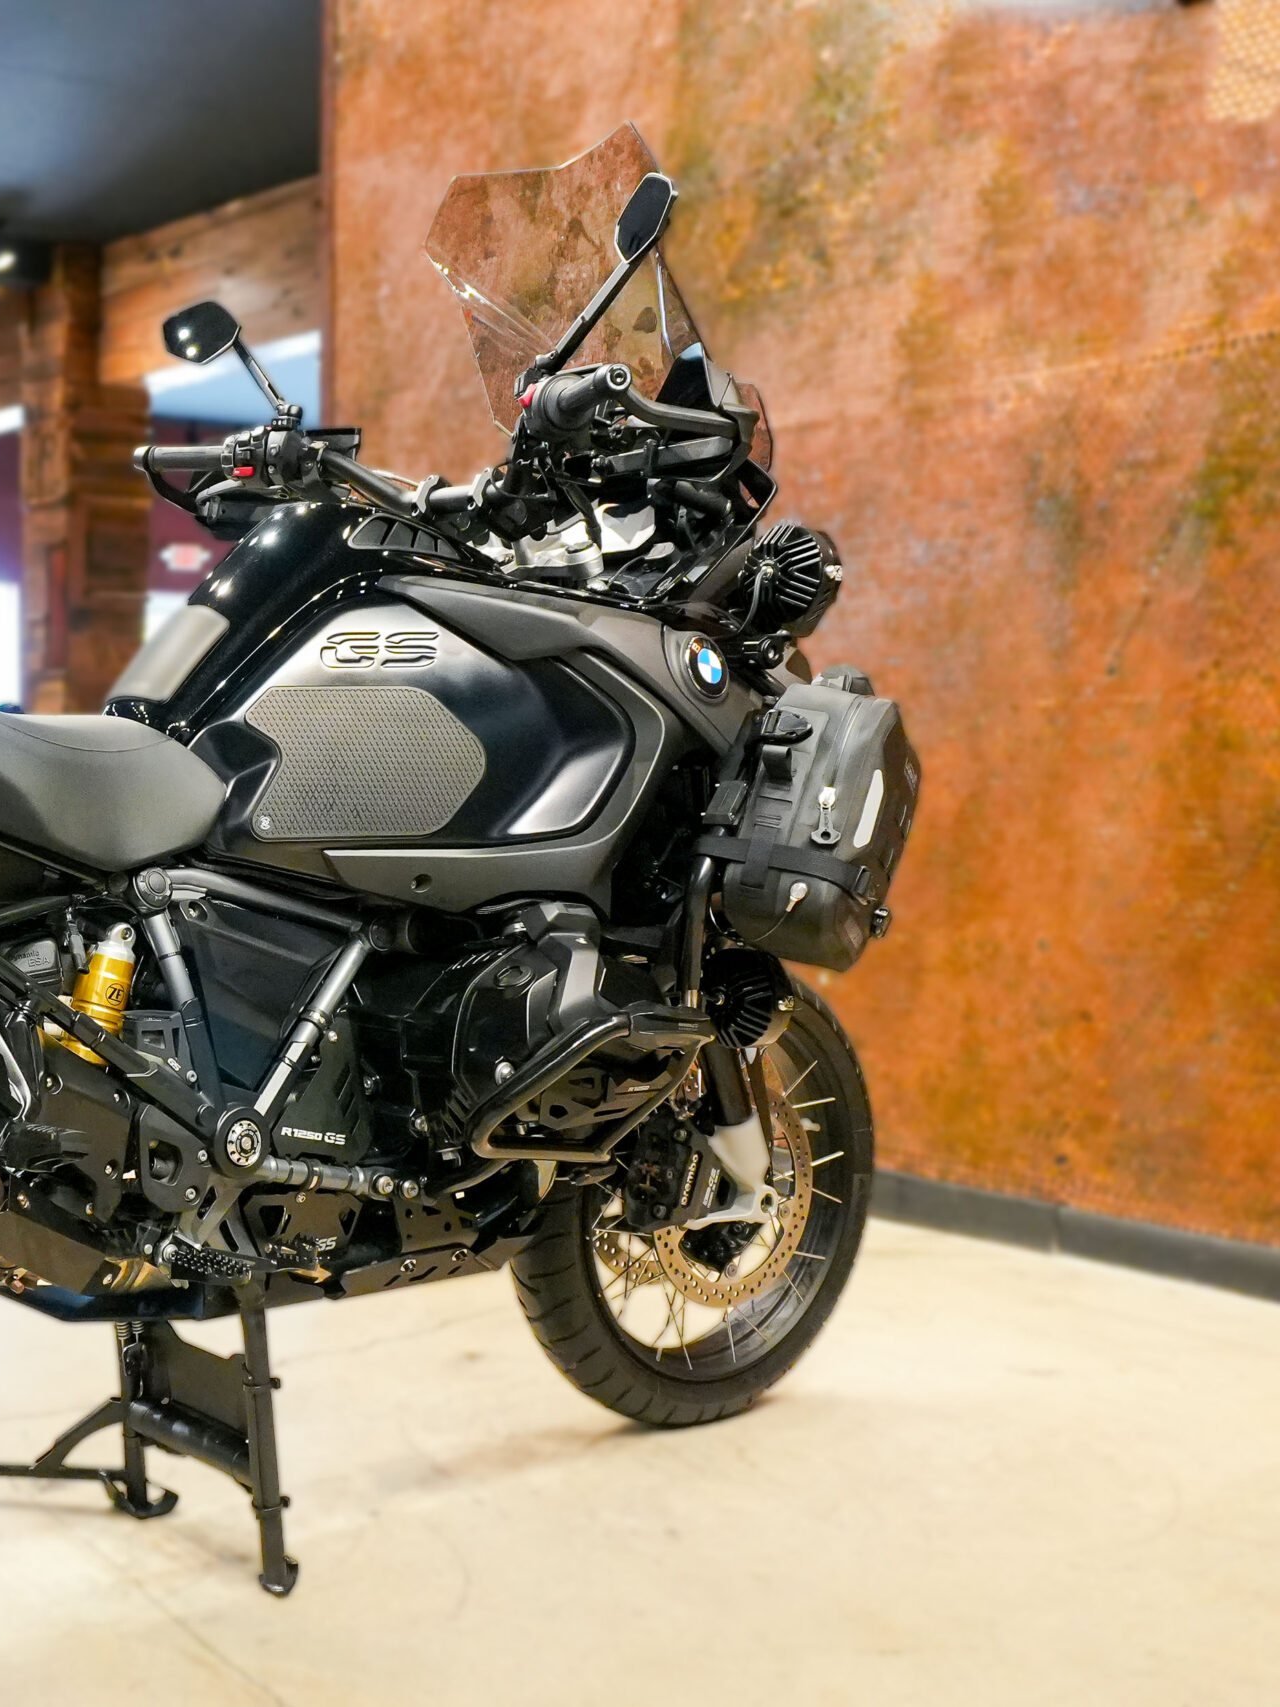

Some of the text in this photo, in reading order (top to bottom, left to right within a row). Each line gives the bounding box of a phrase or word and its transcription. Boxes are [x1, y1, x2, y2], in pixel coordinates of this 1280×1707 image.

[320, 631, 439, 668] GS
[107, 986, 124, 1003] ZF
[280, 1126, 347, 1146] R1250 GS
[680, 1153, 699, 1206] brembo
